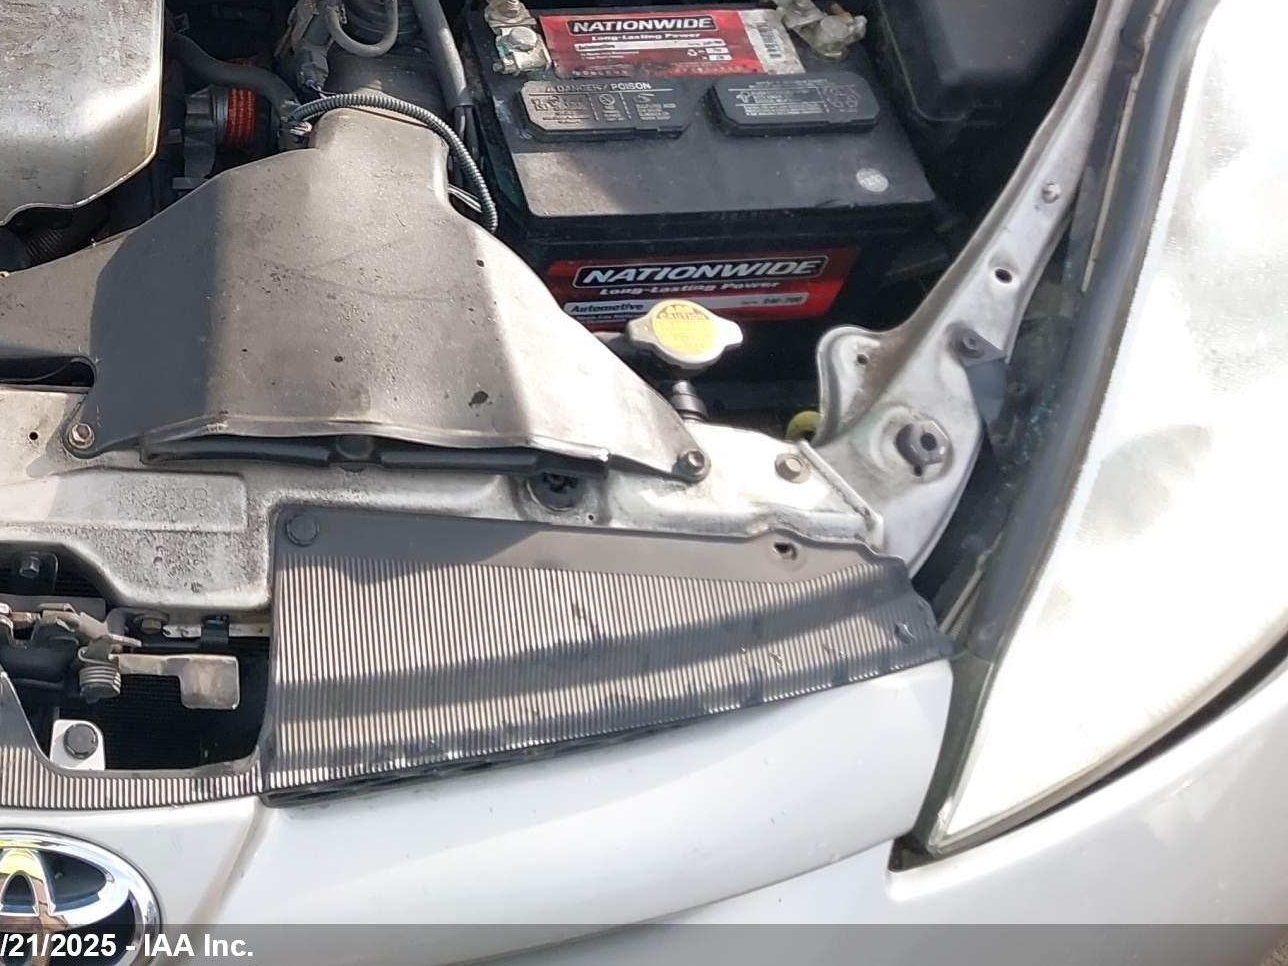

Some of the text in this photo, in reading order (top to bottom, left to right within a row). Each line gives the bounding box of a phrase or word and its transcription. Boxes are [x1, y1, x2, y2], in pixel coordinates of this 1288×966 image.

[573, 17, 714, 33] NATIONWIDE
[591, 34, 662, 42] Long-Lasting
[610, 81, 652, 91] POISON
[582, 261, 821, 284] NATIONWIDE
[599, 281, 781, 296] Long-Lasting Power
[570, 303, 644, 313] Automotive
